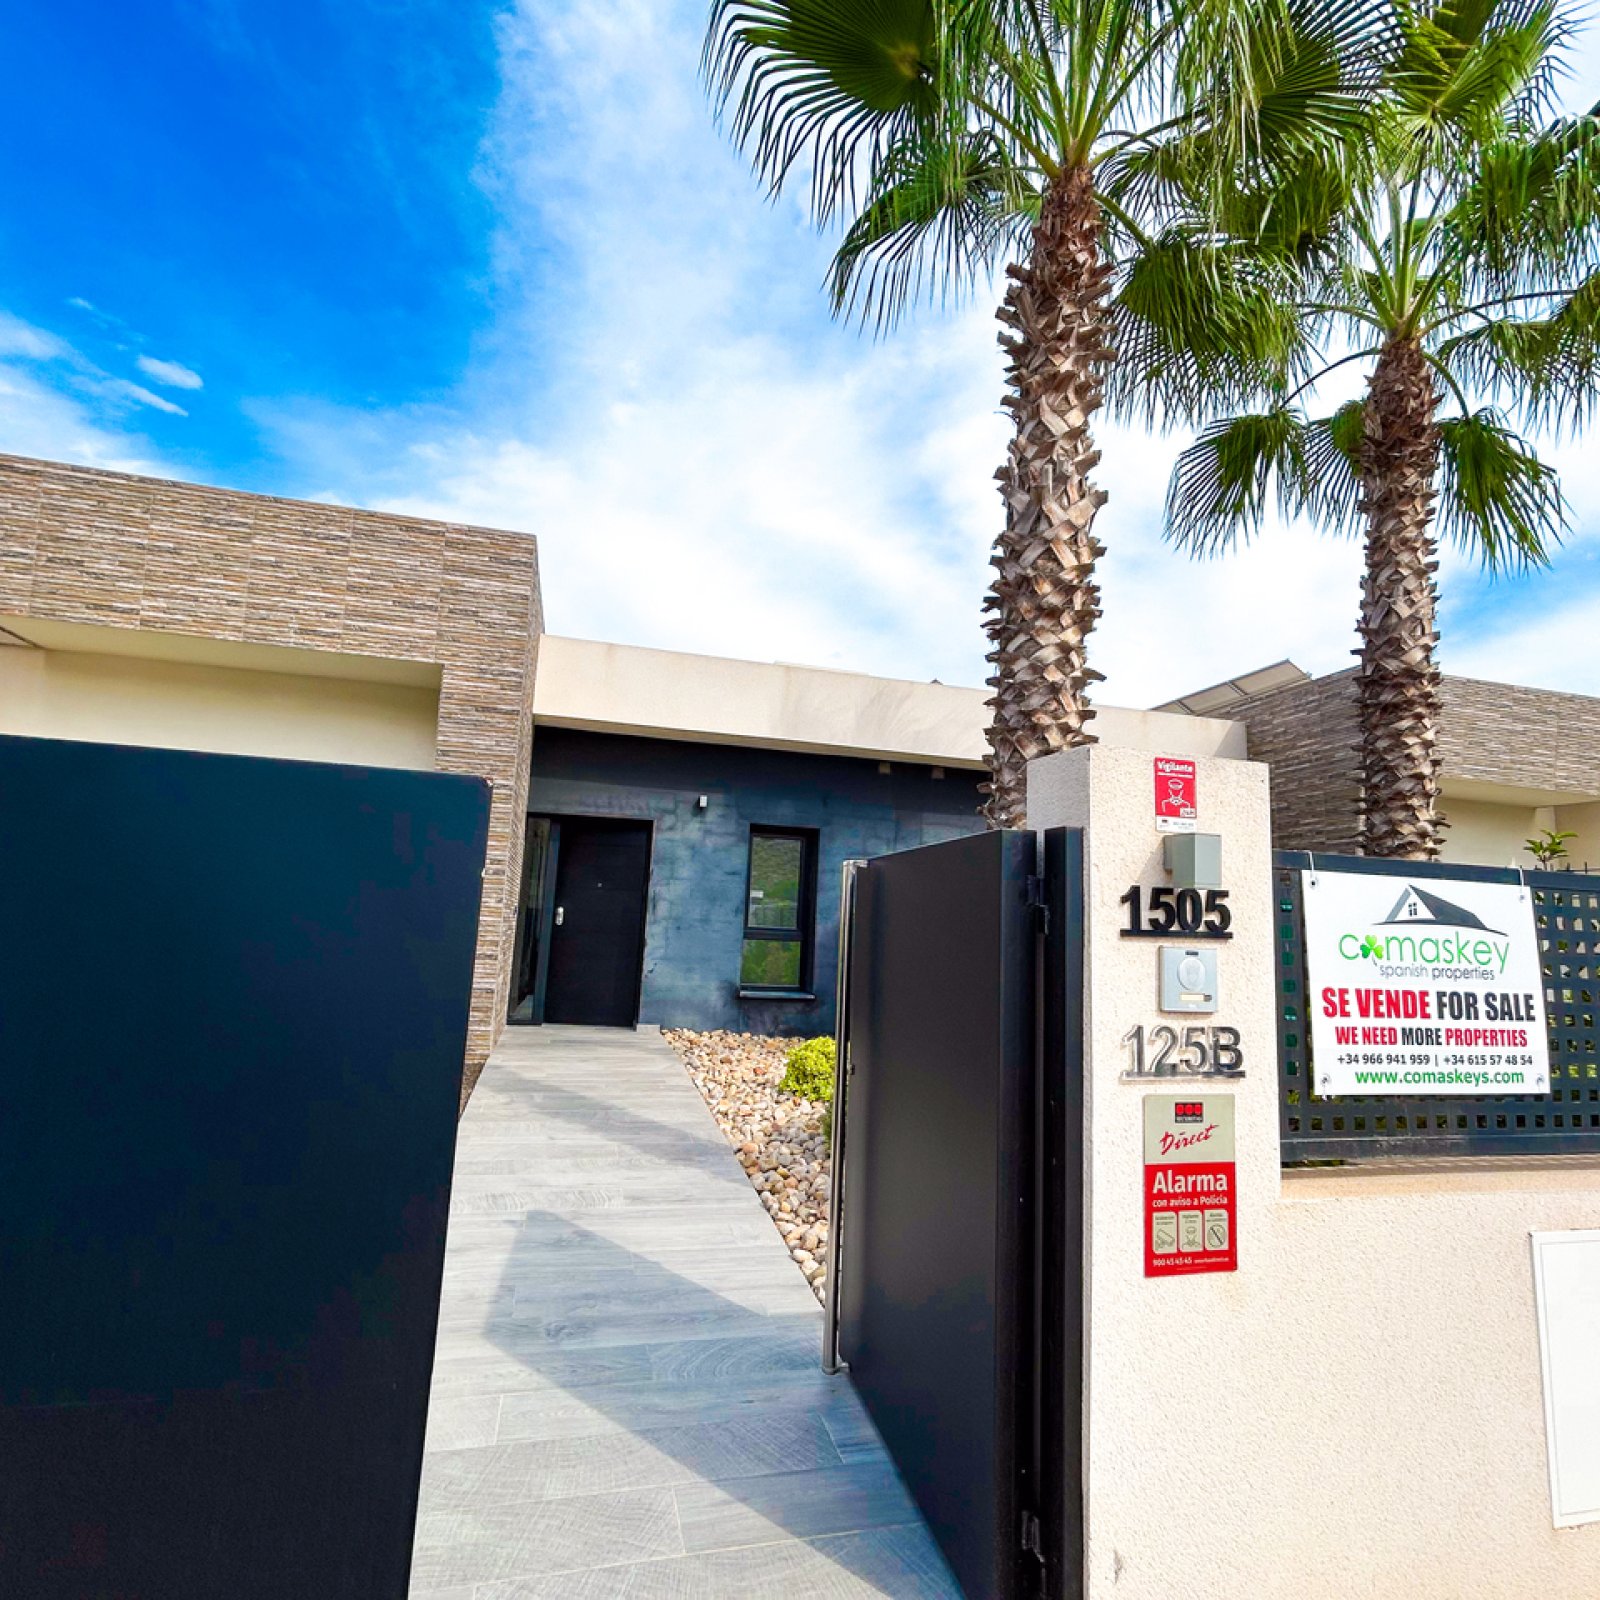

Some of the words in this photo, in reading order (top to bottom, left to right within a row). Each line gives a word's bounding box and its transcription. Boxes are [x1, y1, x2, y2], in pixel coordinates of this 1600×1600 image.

[1120, 885, 1232, 932] 1505
[1379, 964, 1429, 979] spanish
[1432, 966, 1495, 981] properties
[1321, 986, 1351, 1018] SE
[1355, 988, 1431, 1019] VENDE
[1436, 991, 1480, 1020] FOR
[1484, 992, 1536, 1022] SALE
[1335, 1026, 1359, 1045] WE
[1362, 1026, 1398, 1046] NEED
[1401, 1028, 1442, 1046] MORE
[1445, 1029, 1528, 1047] PROPERTIES
[1121, 1025, 1244, 1074] 125B
[1337, 1053, 1360, 1065] +34
[1362, 1053, 1383, 1065] 966
[1386, 1054, 1406, 1065] 941
[1409, 1054, 1430, 1065] 959
[1443, 1054, 1465, 1065] +34
[1467, 1055, 1487, 1066] 615
[1489, 1055, 1502, 1066] 57
[1504, 1055, 1518, 1066] 48
[1520, 1055, 1533, 1066] 54
[1355, 1068, 1525, 1087] www.comaskeys.com
[1160, 1124, 1220, 1155] Direct
[1152, 1169, 1228, 1194] Alarma
[1152, 1199, 1168, 1208] con
[1169, 1196, 1192, 1207] aviso
